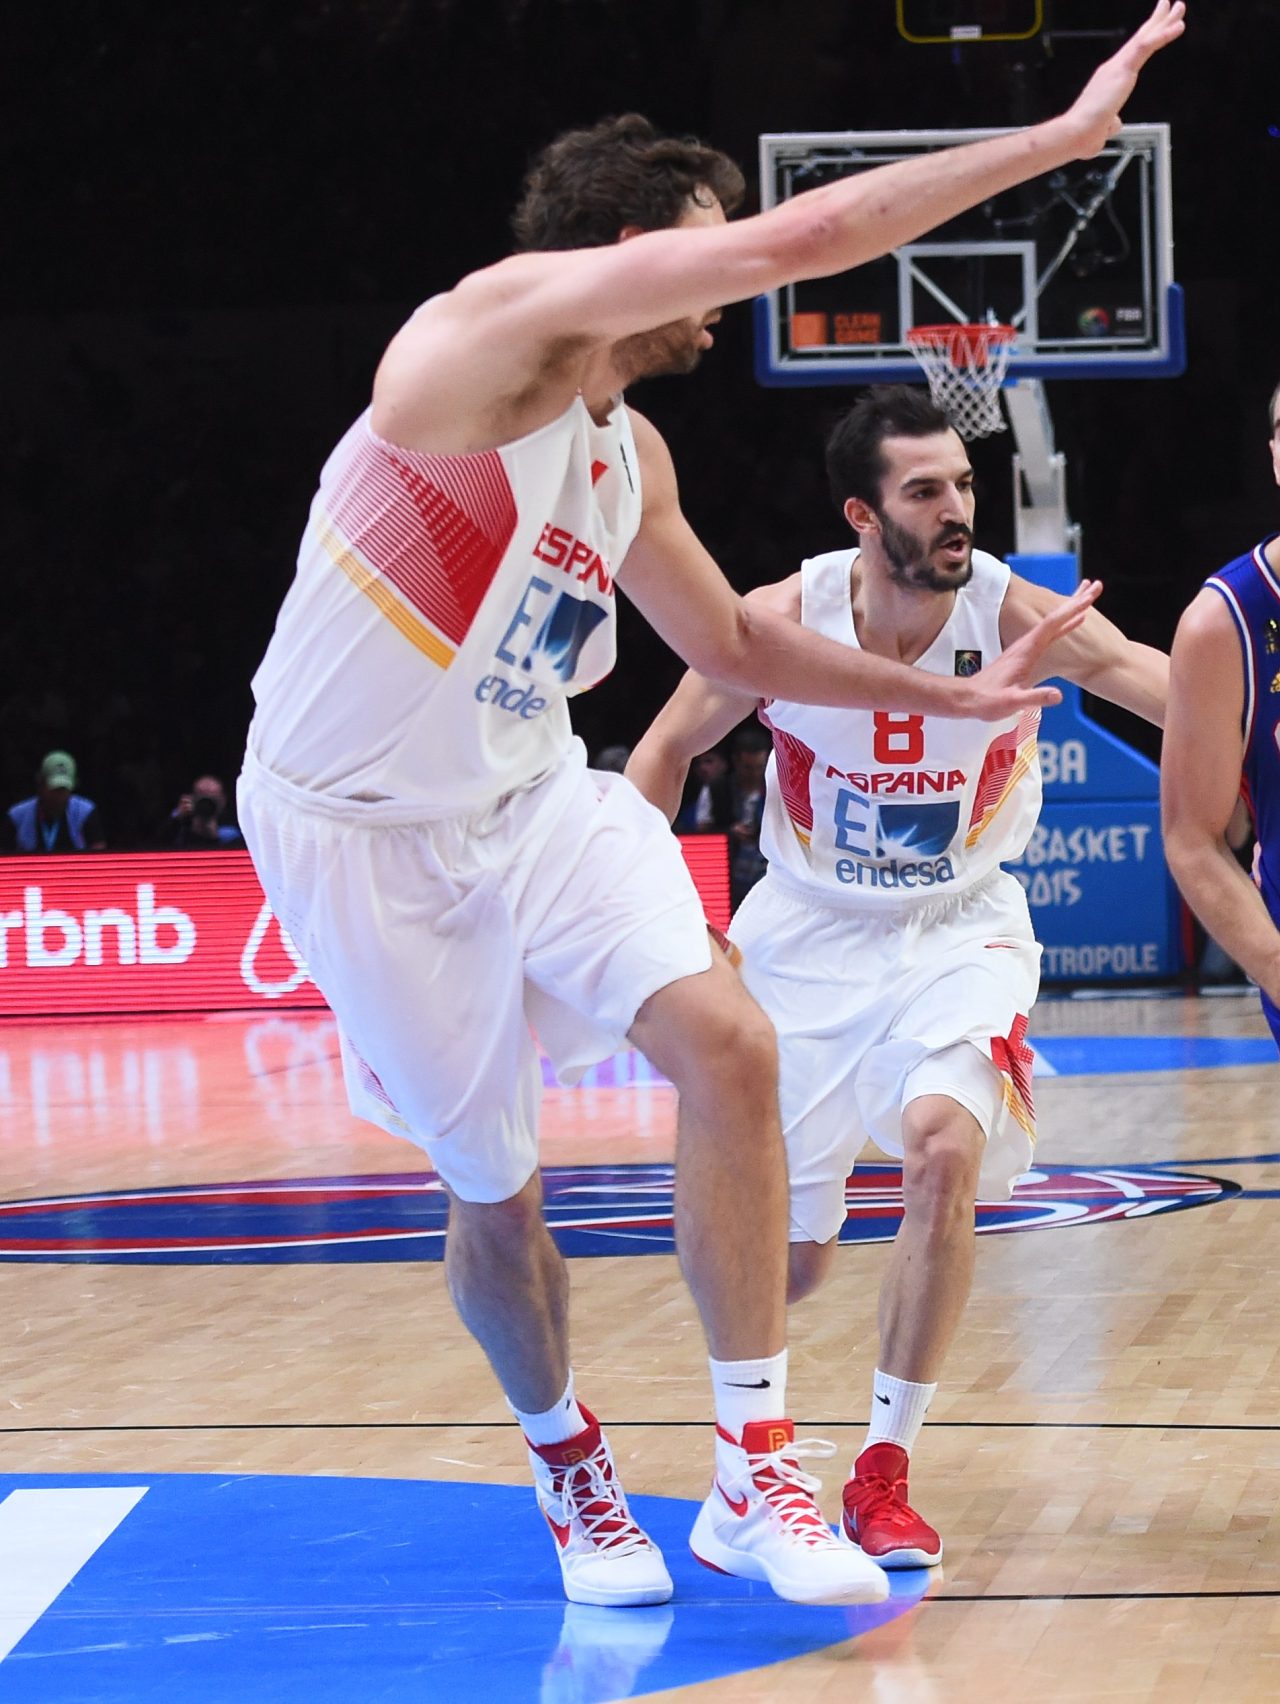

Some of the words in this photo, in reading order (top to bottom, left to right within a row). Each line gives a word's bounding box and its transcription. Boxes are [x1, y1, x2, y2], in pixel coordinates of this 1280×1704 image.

[874, 711, 924, 764] 8
[1008, 823, 1152, 868] BASKET
[835, 856, 956, 889] endesa
[1041, 943, 1159, 976] TROPOLE
